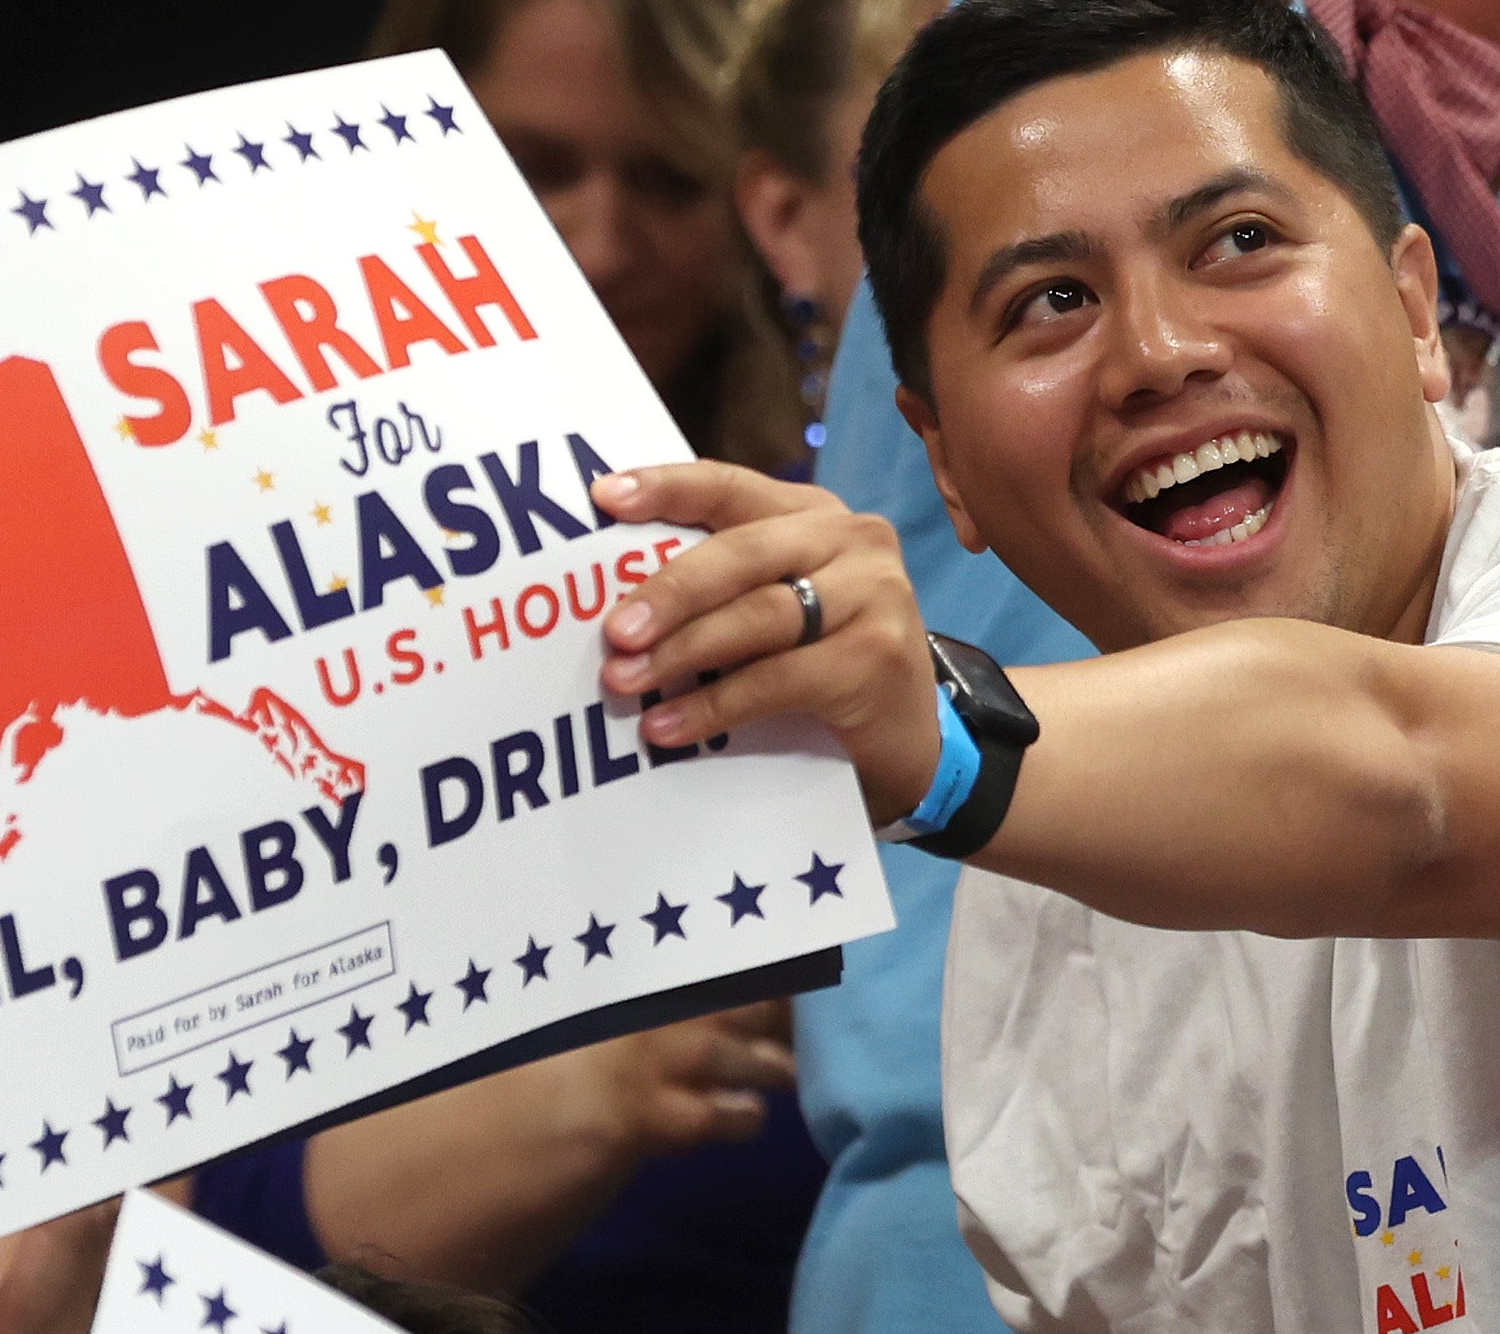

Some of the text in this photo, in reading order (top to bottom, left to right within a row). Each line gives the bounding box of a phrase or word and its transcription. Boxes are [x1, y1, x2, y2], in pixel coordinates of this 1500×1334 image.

[96, 234, 539, 448] SARAH
[328, 400, 444, 477] For
[315, 628, 445, 708] U.S.
[102, 792, 401, 963] BABY,
[126, 944, 383, 1054] Paid for by Sarah for Alaska
[1345, 1144, 1449, 1238] SA
